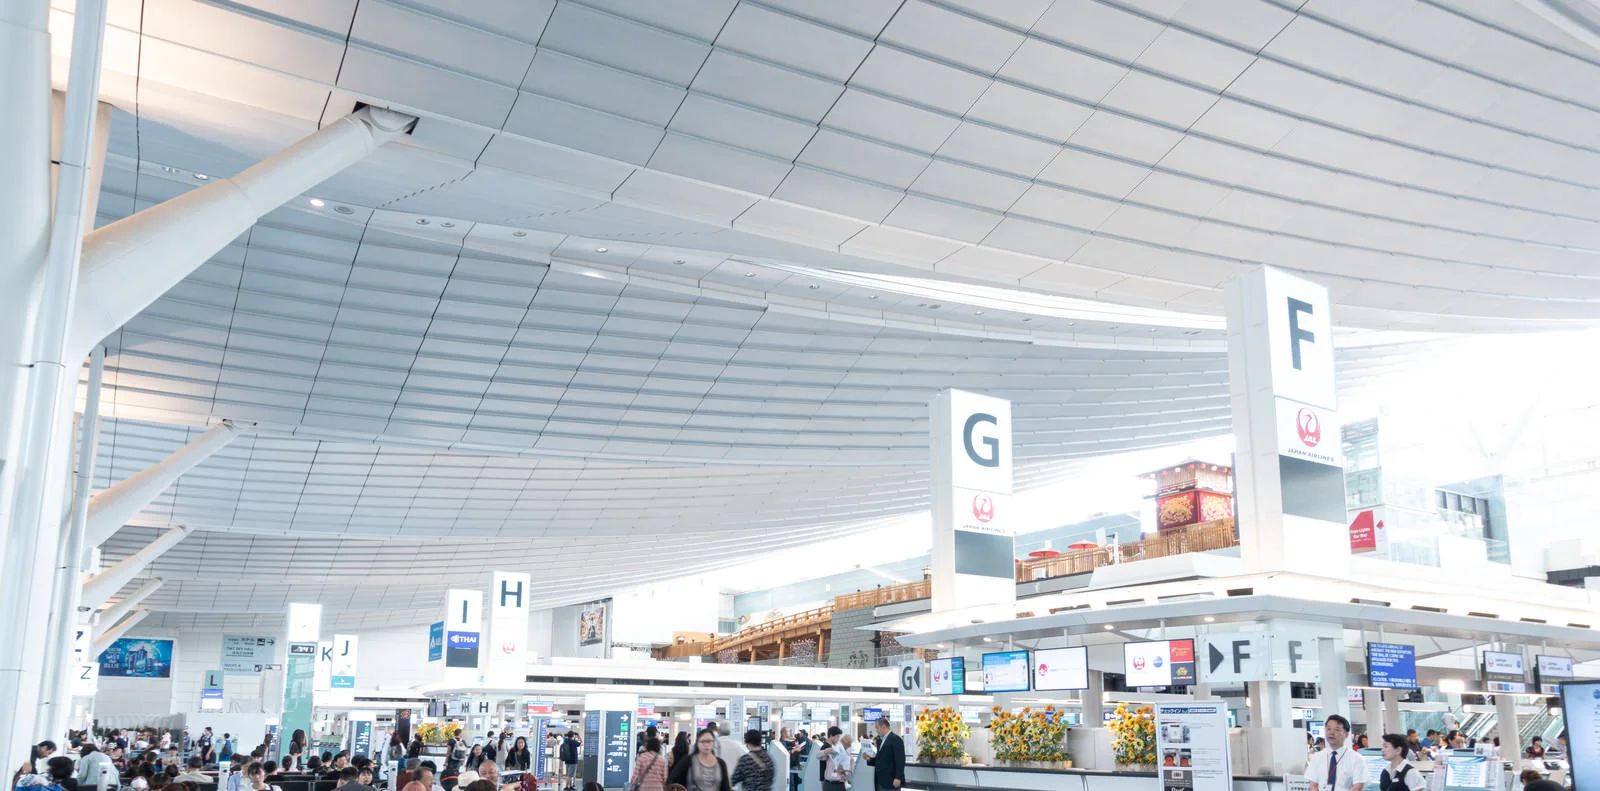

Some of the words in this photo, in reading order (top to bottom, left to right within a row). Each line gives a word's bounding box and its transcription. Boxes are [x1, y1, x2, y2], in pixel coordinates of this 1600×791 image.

[1287, 296, 1315, 371] F
[963, 412, 1000, 468] G
[1288, 448, 1306, 456] JAPAN
[1307, 452, 1335, 462] AIRLINES
[500, 580, 522, 608] H
[321, 647, 332, 661] K
[341, 640, 349, 656] J
[1232, 640, 1250, 674] F
[1288, 640, 1303, 674] F
[80, 666, 92, 679] Z
[210, 675, 217, 686] L
[902, 666, 912, 691] G
[479, 702, 488, 713] H
